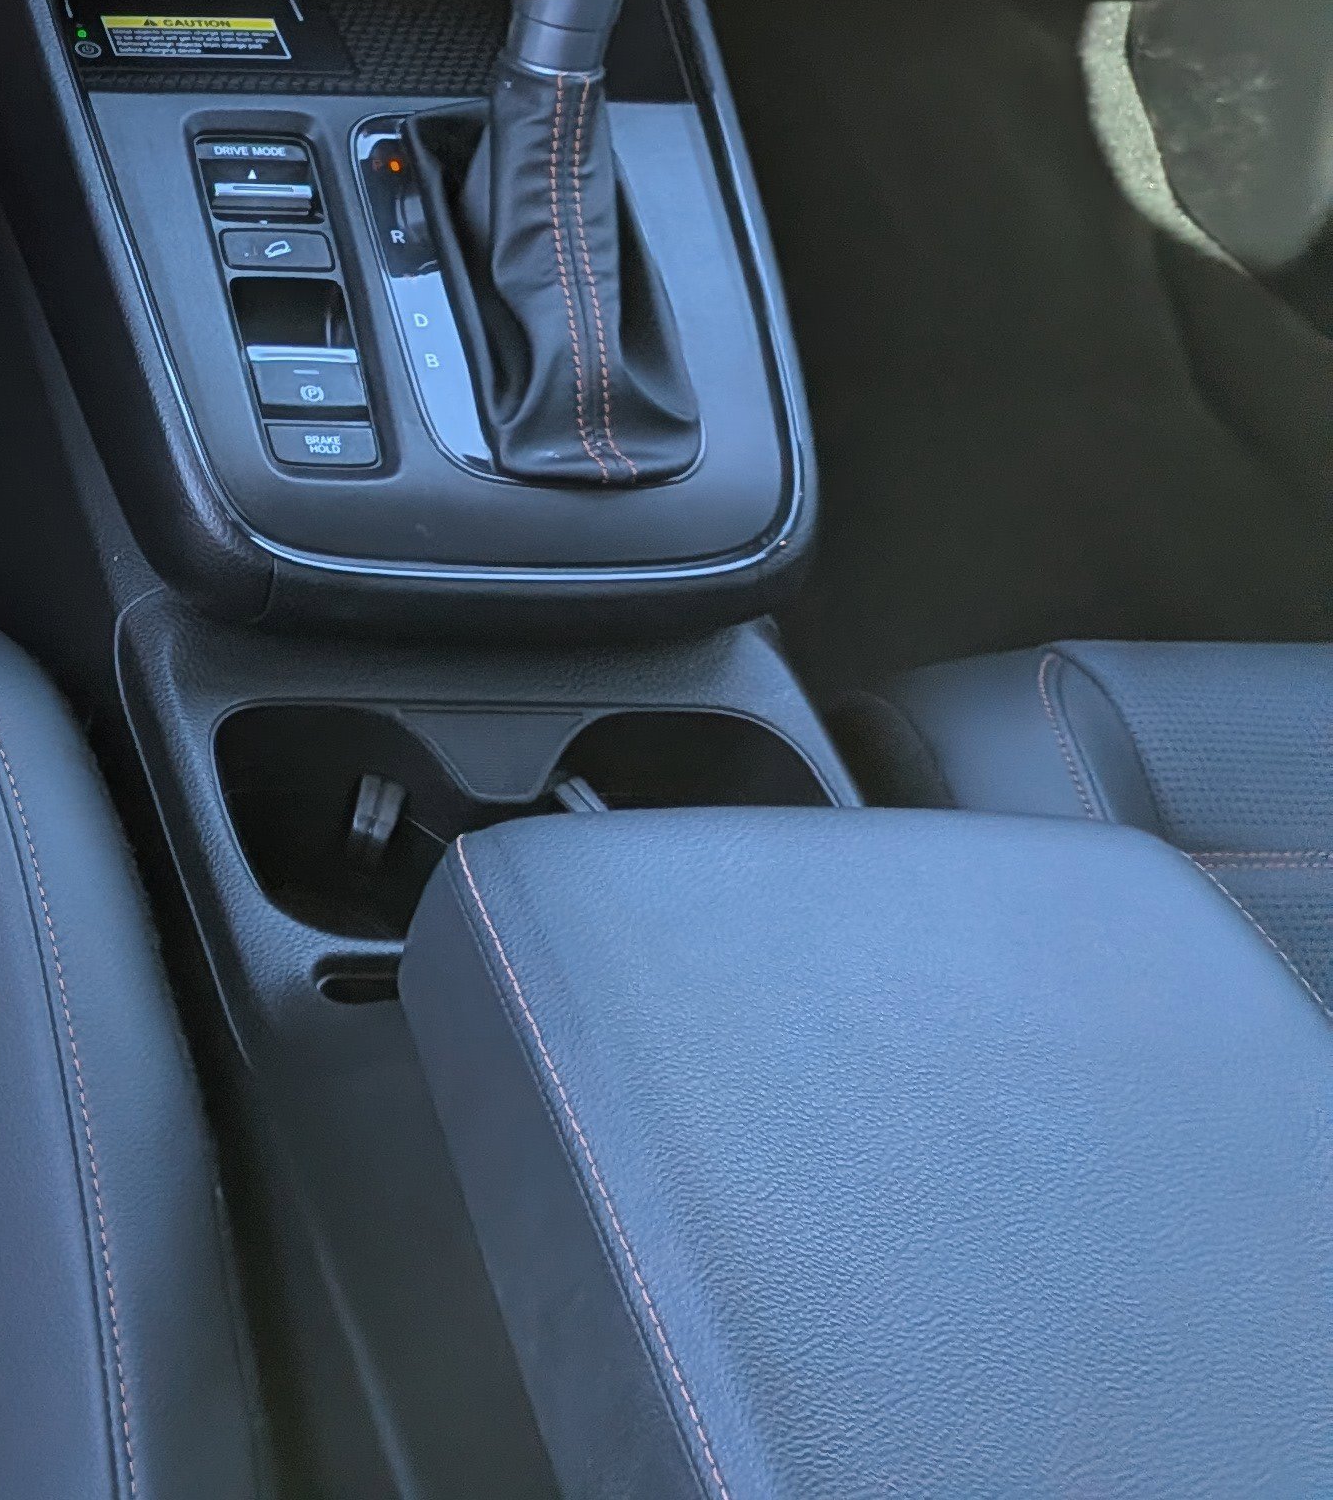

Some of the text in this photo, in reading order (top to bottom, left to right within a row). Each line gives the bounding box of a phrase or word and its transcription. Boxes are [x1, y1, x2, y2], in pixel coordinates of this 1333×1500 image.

[163, 20, 231, 28] CAUTION
[213, 146, 286, 157] DRIVE MODE
[390, 229, 405, 244] R
[414, 313, 429, 327] D
[425, 353, 440, 368] B
[304, 435, 341, 446] BRAKE
[309, 444, 341, 455] HOLD
